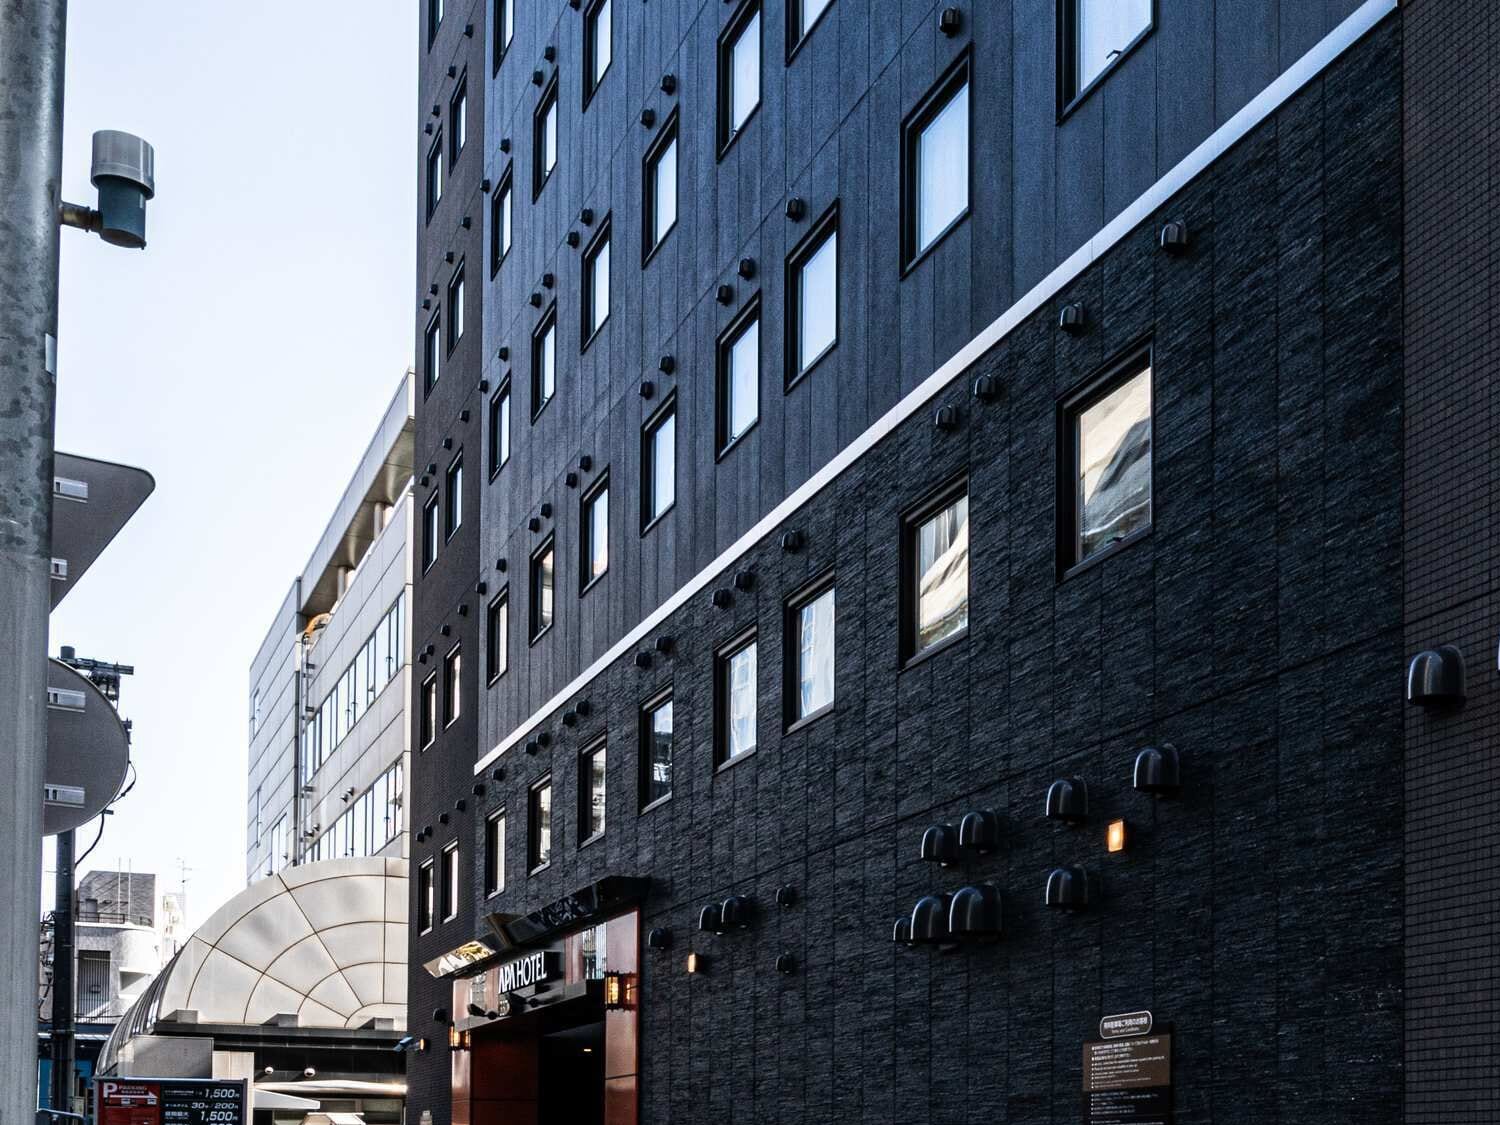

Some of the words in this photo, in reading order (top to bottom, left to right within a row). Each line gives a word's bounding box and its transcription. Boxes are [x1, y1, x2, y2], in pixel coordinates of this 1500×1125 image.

[498, 964, 516, 994] APA
[516, 951, 548, 989] HOTEL
[103, 1082, 118, 1098] P
